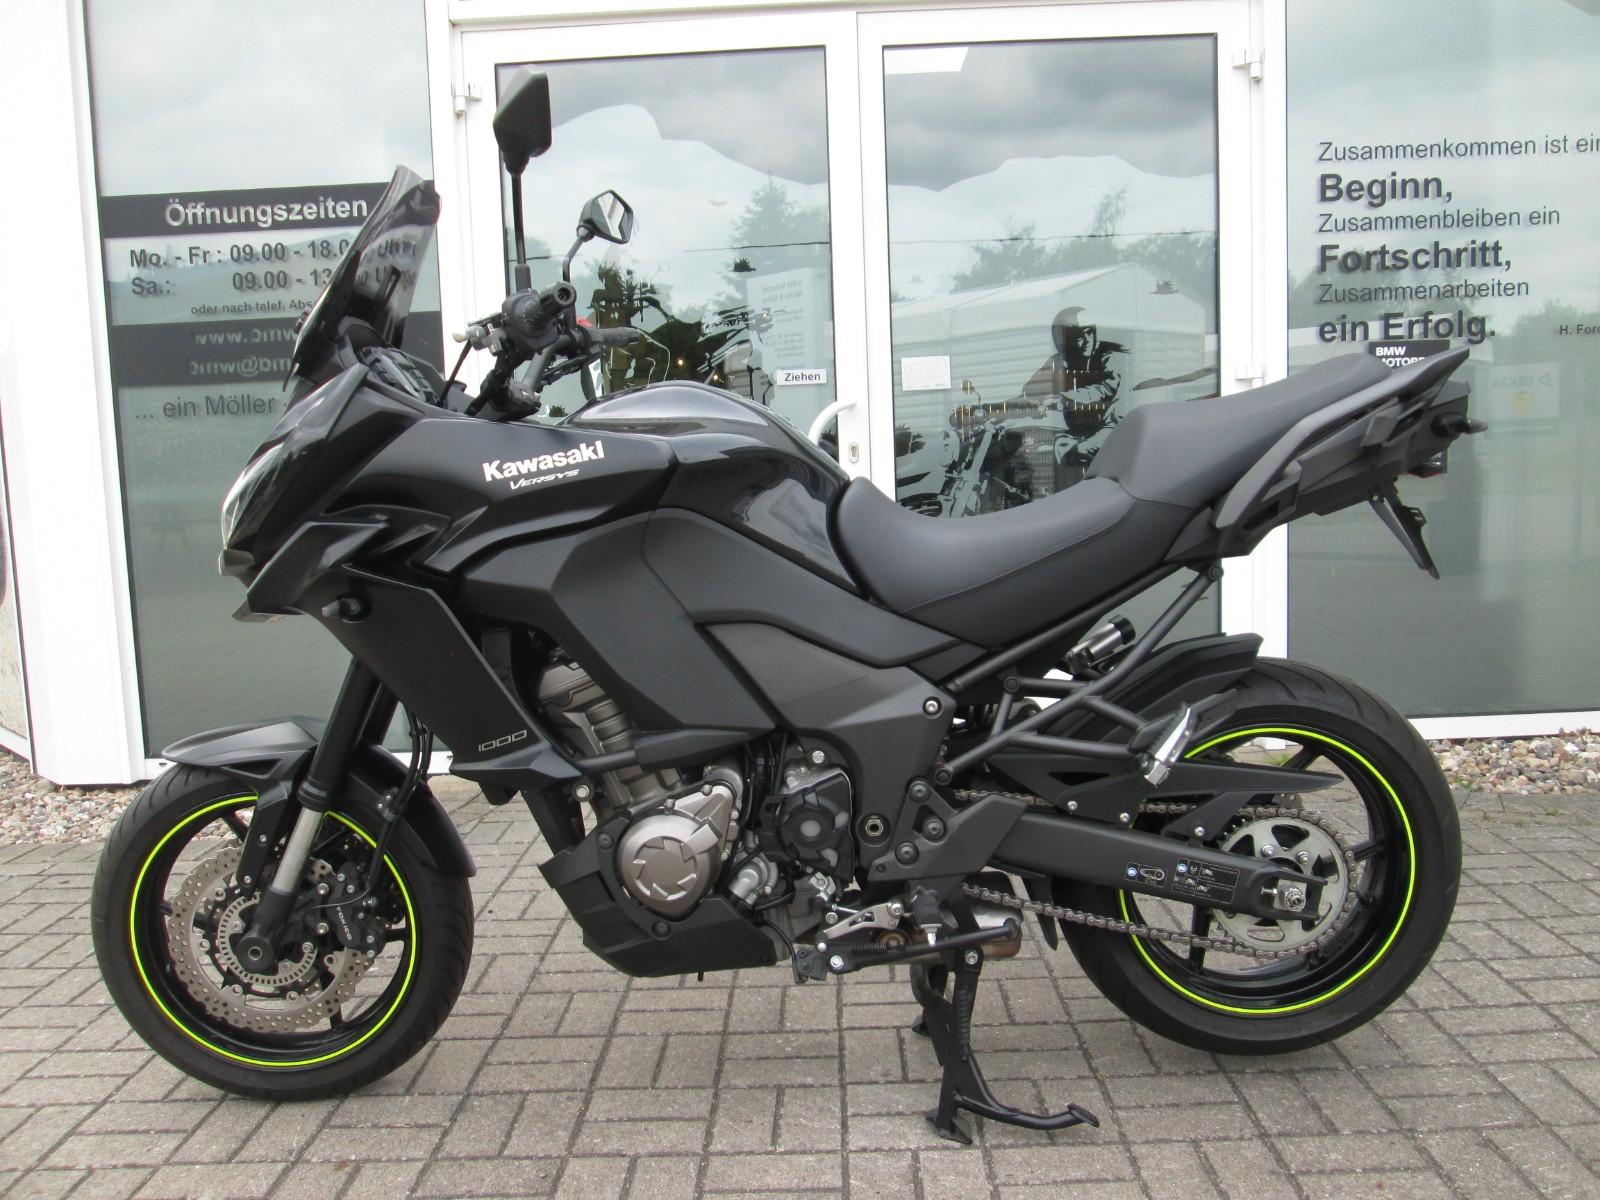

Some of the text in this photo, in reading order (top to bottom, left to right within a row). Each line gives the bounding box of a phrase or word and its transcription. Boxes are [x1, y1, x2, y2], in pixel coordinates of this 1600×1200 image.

[1318, 138, 1536, 162] Zusammenkommen
[1544, 134, 1568, 154] ist
[1319, 171, 1453, 208] Beginn,
[164, 198, 368, 228] Öffnungszeiten
[1318, 206, 1560, 233] Zusammenbleiben ein
[130, 248, 168, 268] Mo.
[230, 242, 286, 262] 09.00
[308, 239, 350, 258] 18.0
[1319, 239, 1512, 272] Fortschritt,
[232, 270, 288, 291] 09.00
[1318, 279, 1529, 304] Zusammenarbeiten
[191, 304, 218, 315] oder
[222, 302, 252, 313] nach
[289, 298, 313, 311] Abs
[1318, 310, 1496, 345] ein Erfolg.
[1559, 324, 1572, 336] H.
[1375, 346, 1406, 357] BMW
[190, 355, 292, 378] bmw@bm
[784, 371, 821, 382] Ziehen
[162, 396, 197, 418] ein
[204, 394, 276, 416] Möller
[482, 440, 605, 482] Kawasaki
